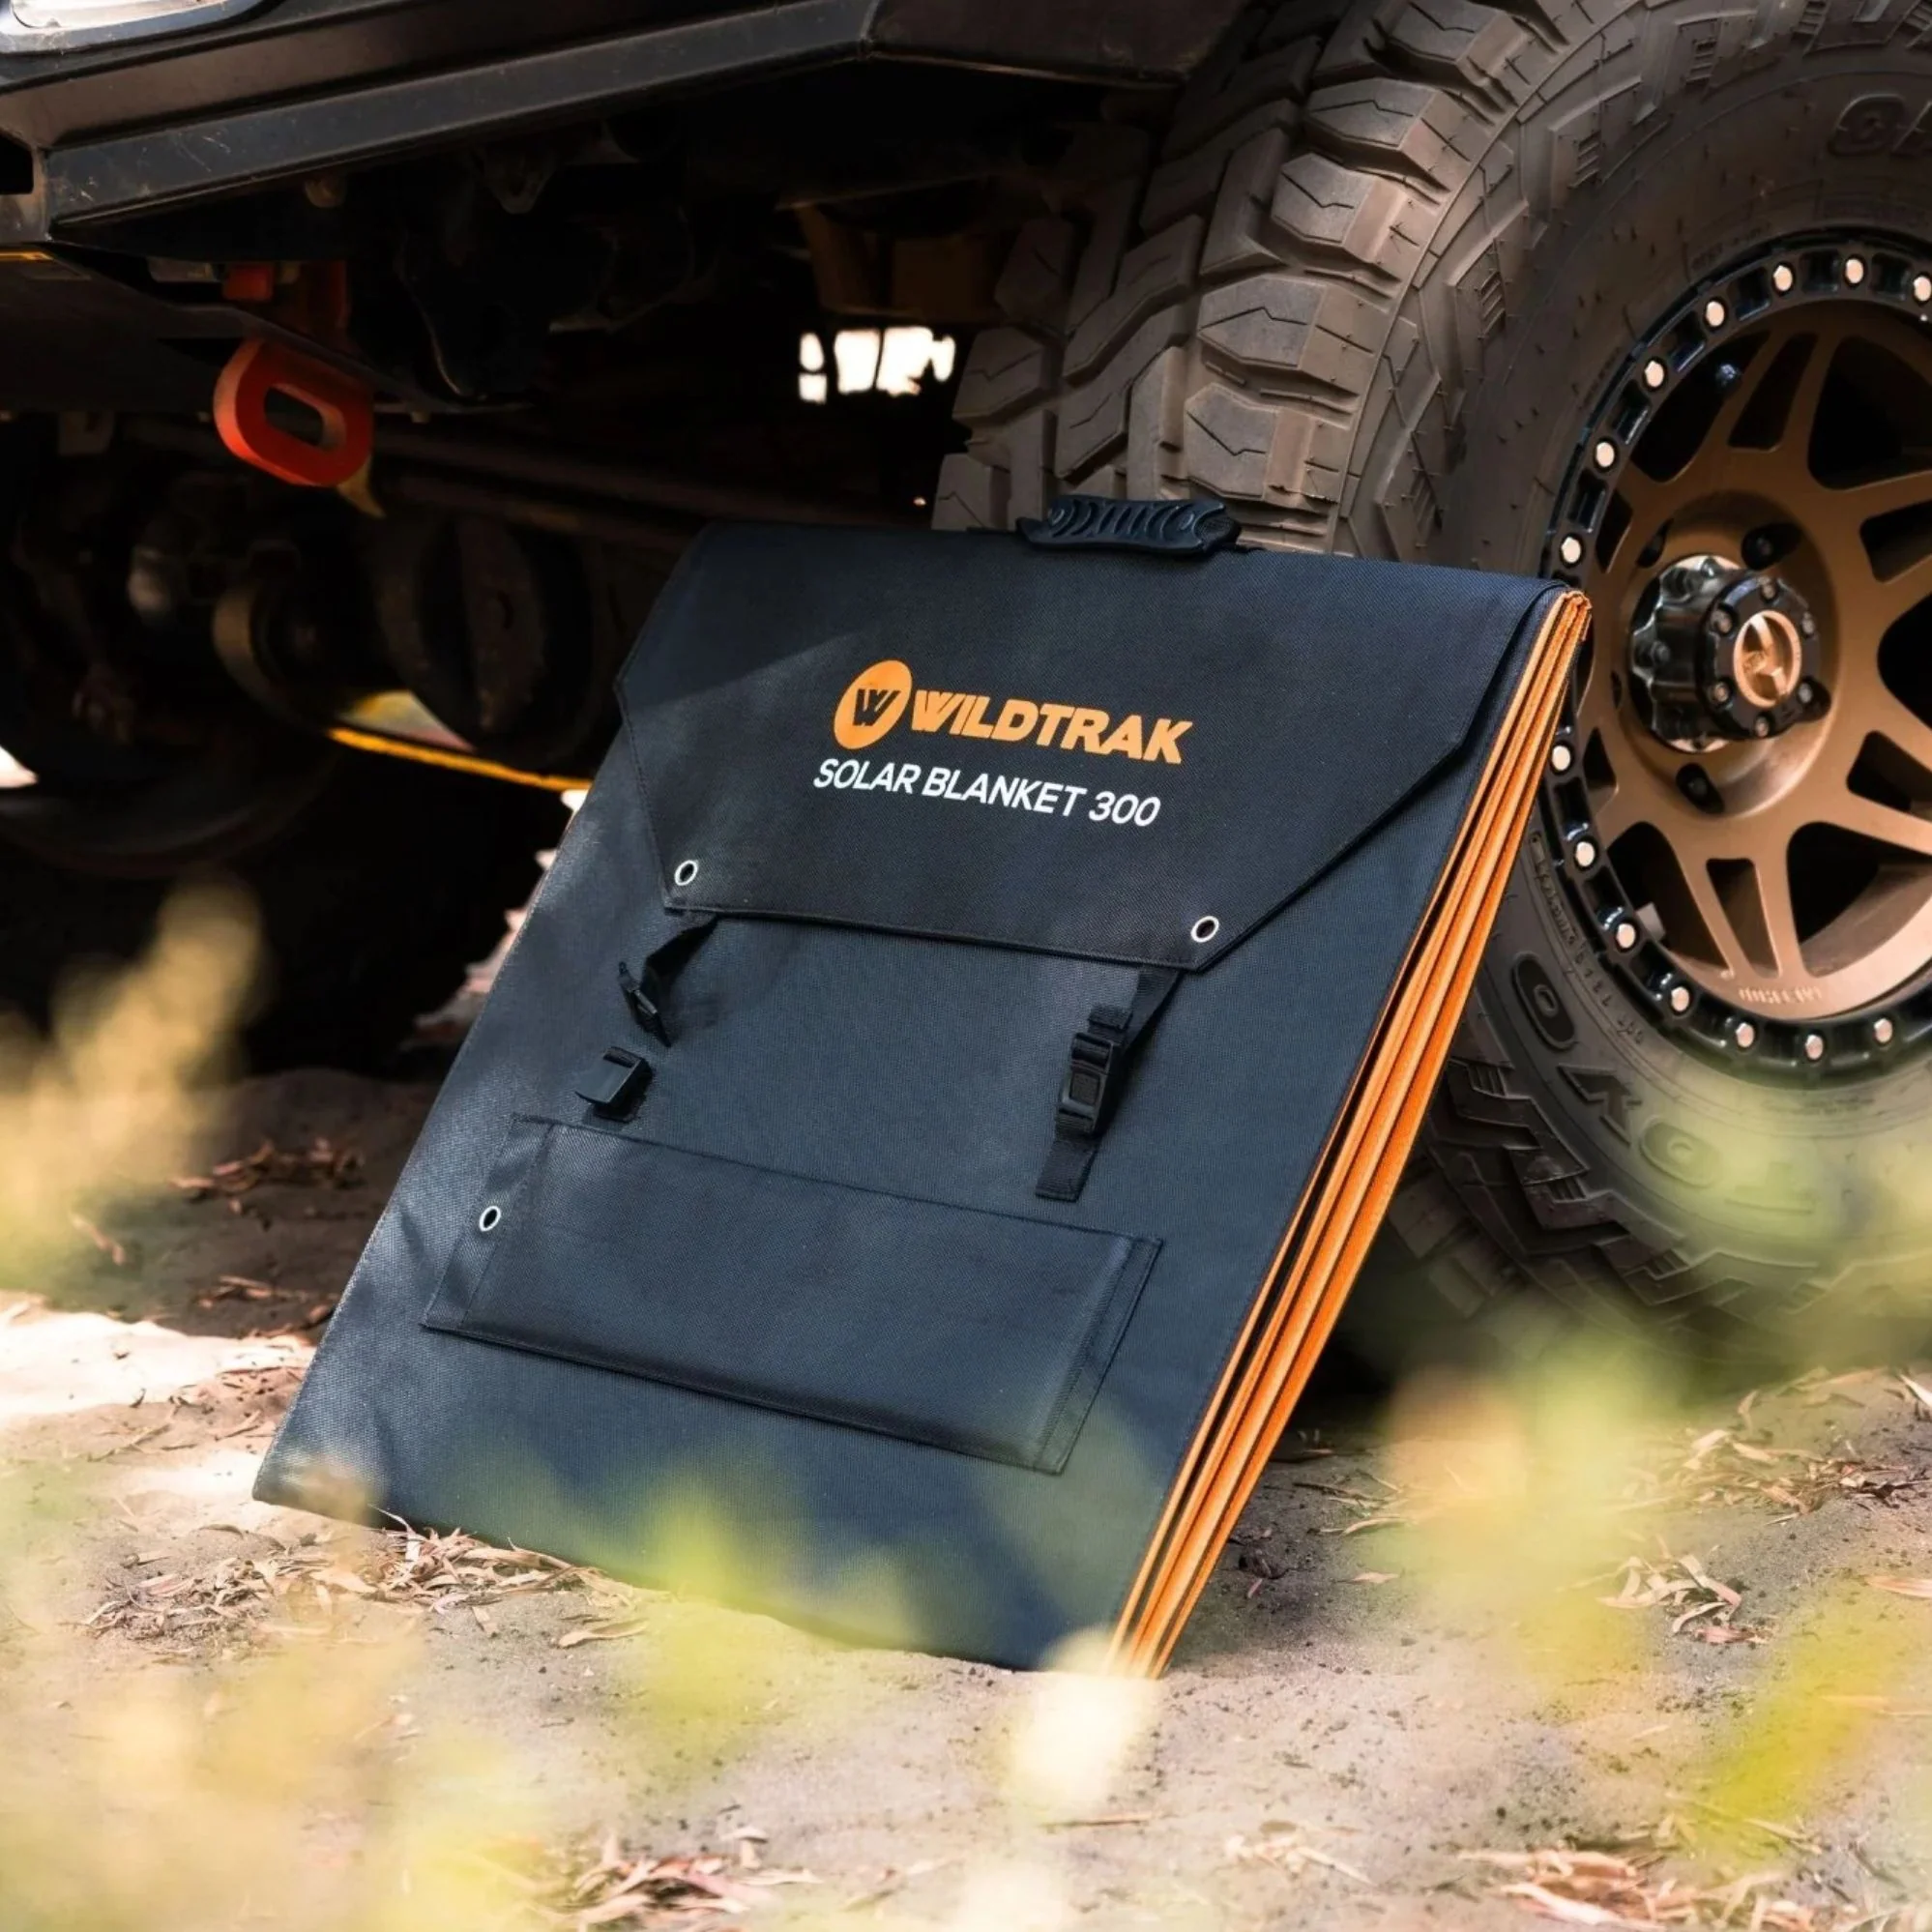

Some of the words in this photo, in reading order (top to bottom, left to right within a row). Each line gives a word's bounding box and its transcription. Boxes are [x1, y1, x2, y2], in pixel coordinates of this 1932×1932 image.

[911, 689, 1192, 764] WILDTRAK
[813, 758, 921, 794] SOLAR
[922, 768, 1086, 816] BLANKET
[1088, 791, 1160, 827] 300
